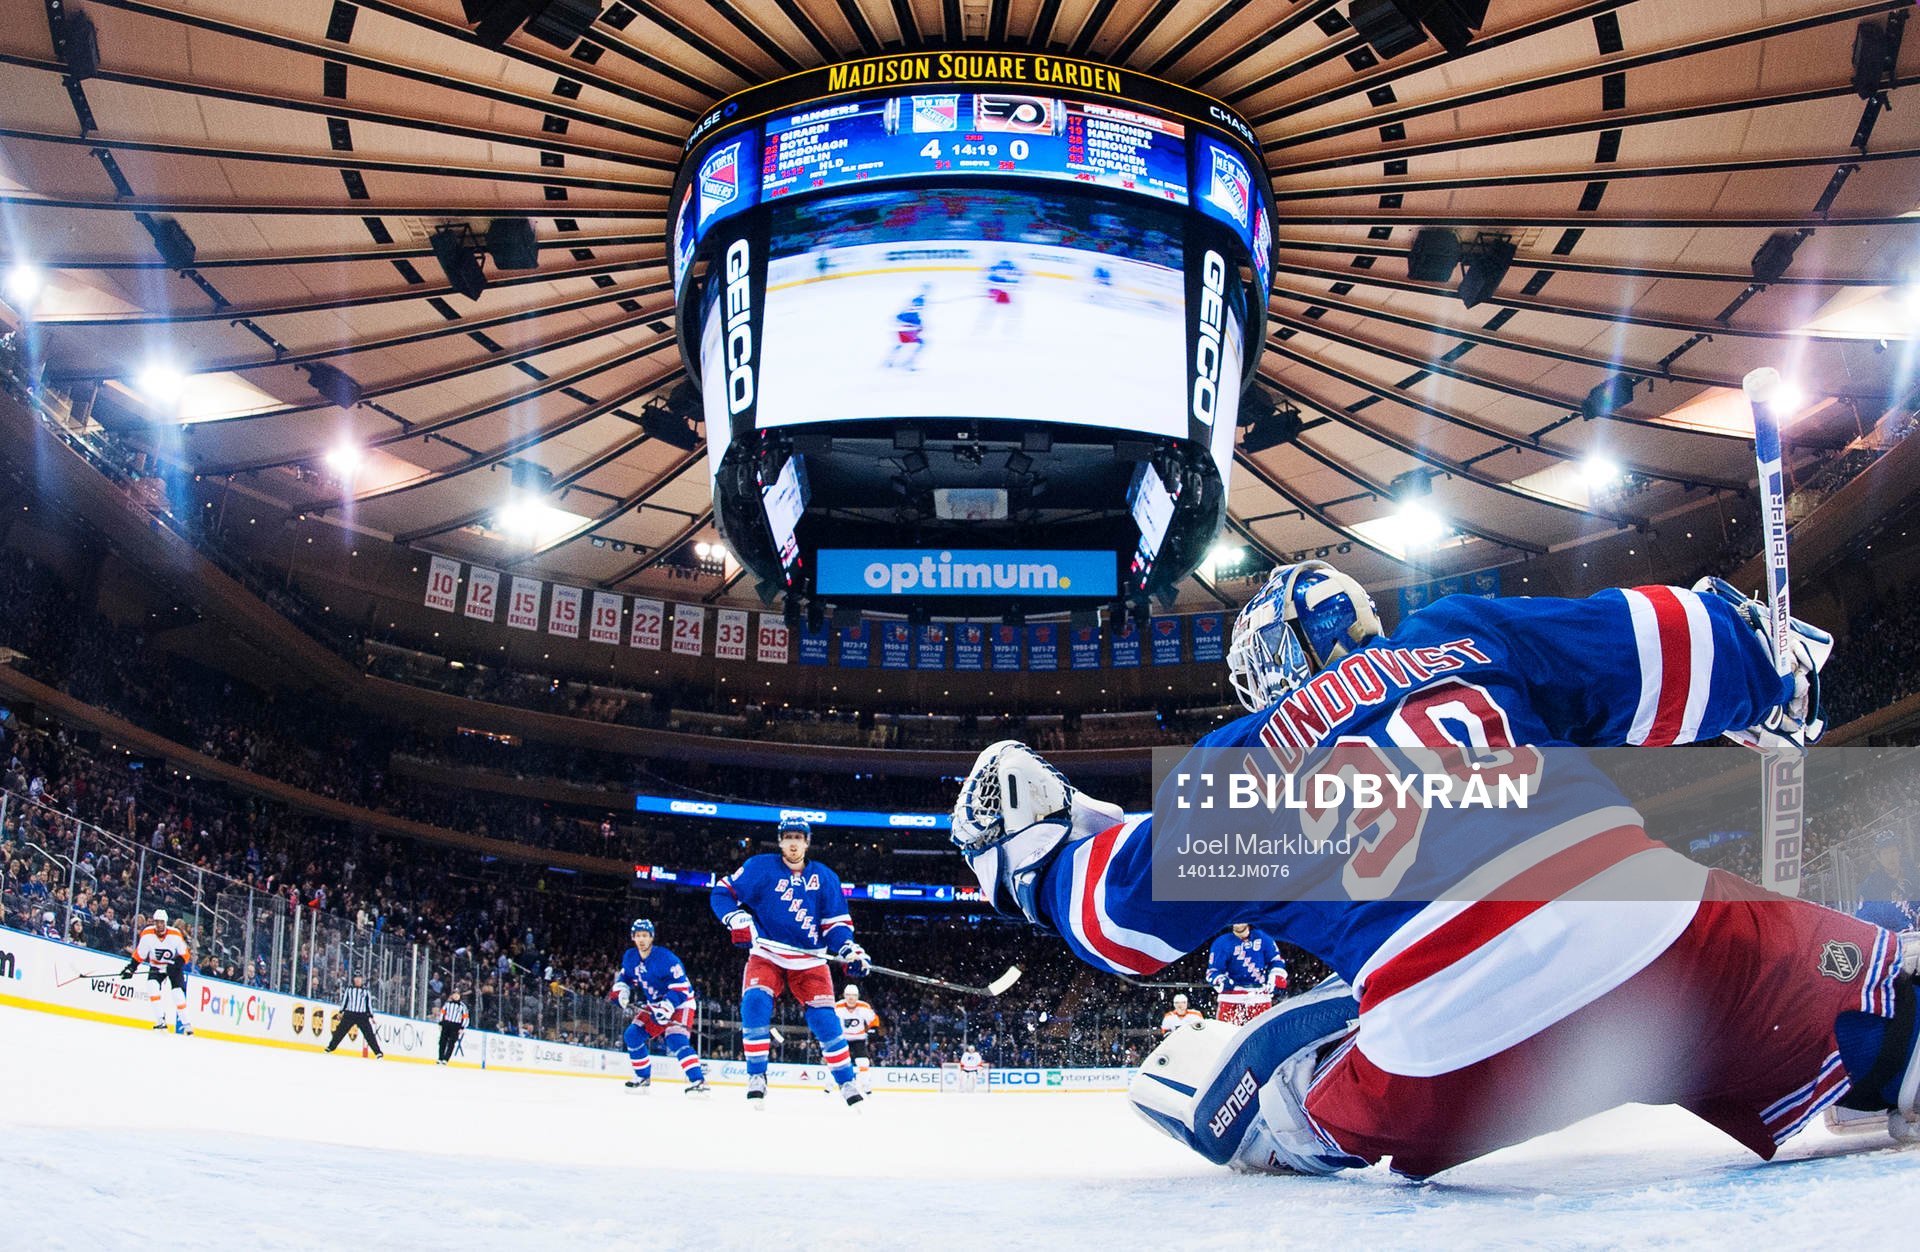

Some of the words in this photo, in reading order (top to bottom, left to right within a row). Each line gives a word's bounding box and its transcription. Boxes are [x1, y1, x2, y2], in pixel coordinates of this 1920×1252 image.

[828, 57, 930, 92] MADISON
[937, 53, 1026, 80] SQUARE
[1034, 56, 1122, 94] GARDEN
[791, 104, 859, 126] RANGERS
[1209, 105, 1254, 144] CHASE
[780, 123, 830, 142] GIRARDI
[1068, 116, 1083, 126] 17
[1086, 119, 1152, 140] SIMMONDS
[1087, 128, 1152, 149] HARTNELL
[779, 139, 848, 161] MCDONAGH
[780, 135, 819, 152] BOYLE
[920, 139, 942, 159] 4
[952, 144, 998, 156] 14:19
[1009, 139, 1029, 160] 0
[1087, 138, 1136, 155] GIROUX
[778, 152, 831, 171] HAGELIN
[819, 158, 844, 171] HLD
[1087, 147, 1145, 167] TIMONEN
[1088, 157, 1148, 177] VORACEK
[725, 238, 754, 415] GEICO
[1192, 249, 1226, 427] GEICO
[863, 551, 1072, 594] optimum.
[432, 573, 453, 594] 10
[472, 582, 493, 605] 12
[427, 595, 454, 609] KNICKS
[467, 604, 493, 618] KNICKS
[514, 592, 535, 613] 15
[555, 600, 576, 621] 15
[510, 614, 536, 627] KNICKS
[551, 622, 577, 634] KNICKS
[596, 607, 617, 628] 19
[634, 613, 660, 634] 22
[592, 629, 618, 640] KNICKS
[676, 619, 701, 640] 24
[719, 624, 744, 643] 33
[759, 627, 788, 648] 613
[632, 636, 660, 646] KNICKS
[673, 640, 700, 652] KNICKS
[717, 645, 744, 656] KNICKS
[760, 650, 786, 660] KNICKS
[1243, 638, 1492, 814] LUNDQVIST
[1299, 675, 1545, 901] 30
[670, 801, 718, 815] GEICO
[889, 815, 936, 826] GEICO
[1774, 756, 1803, 883] BAUER
[807, 874, 820, 890] A
[934, 887, 945, 898] 4
[1832, 946, 1852, 975] NHL
[91, 978, 134, 999] verizon
[200, 986, 245, 1026] Party
[246, 995, 276, 1031] City
[888, 1072, 940, 1084] CHASE
[1208, 1070, 1259, 1139] BAUER
